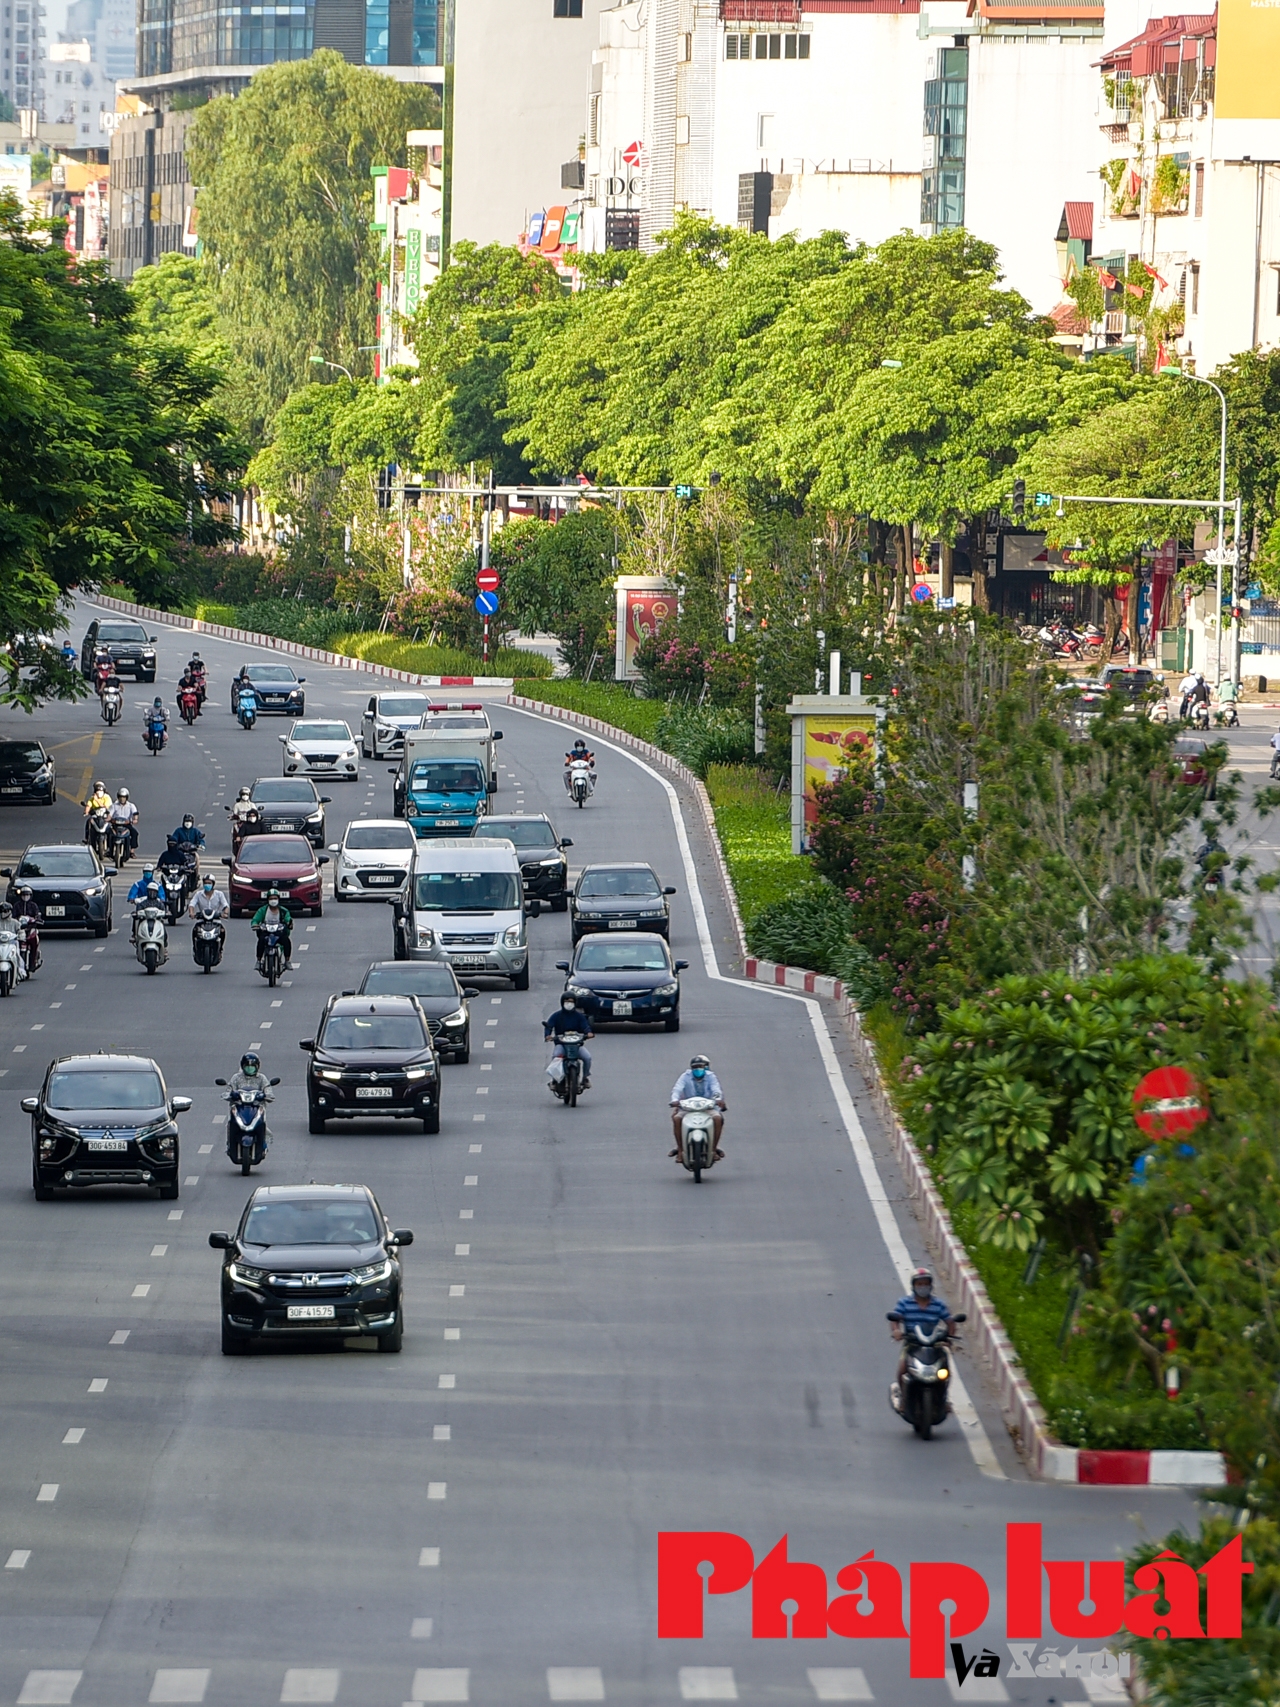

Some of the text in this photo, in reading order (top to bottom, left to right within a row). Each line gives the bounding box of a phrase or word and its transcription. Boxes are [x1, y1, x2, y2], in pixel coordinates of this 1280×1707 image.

[407, 231, 419, 312] EVERON
[676, 486, 690, 497] 34
[1036, 493, 1051, 506] 34
